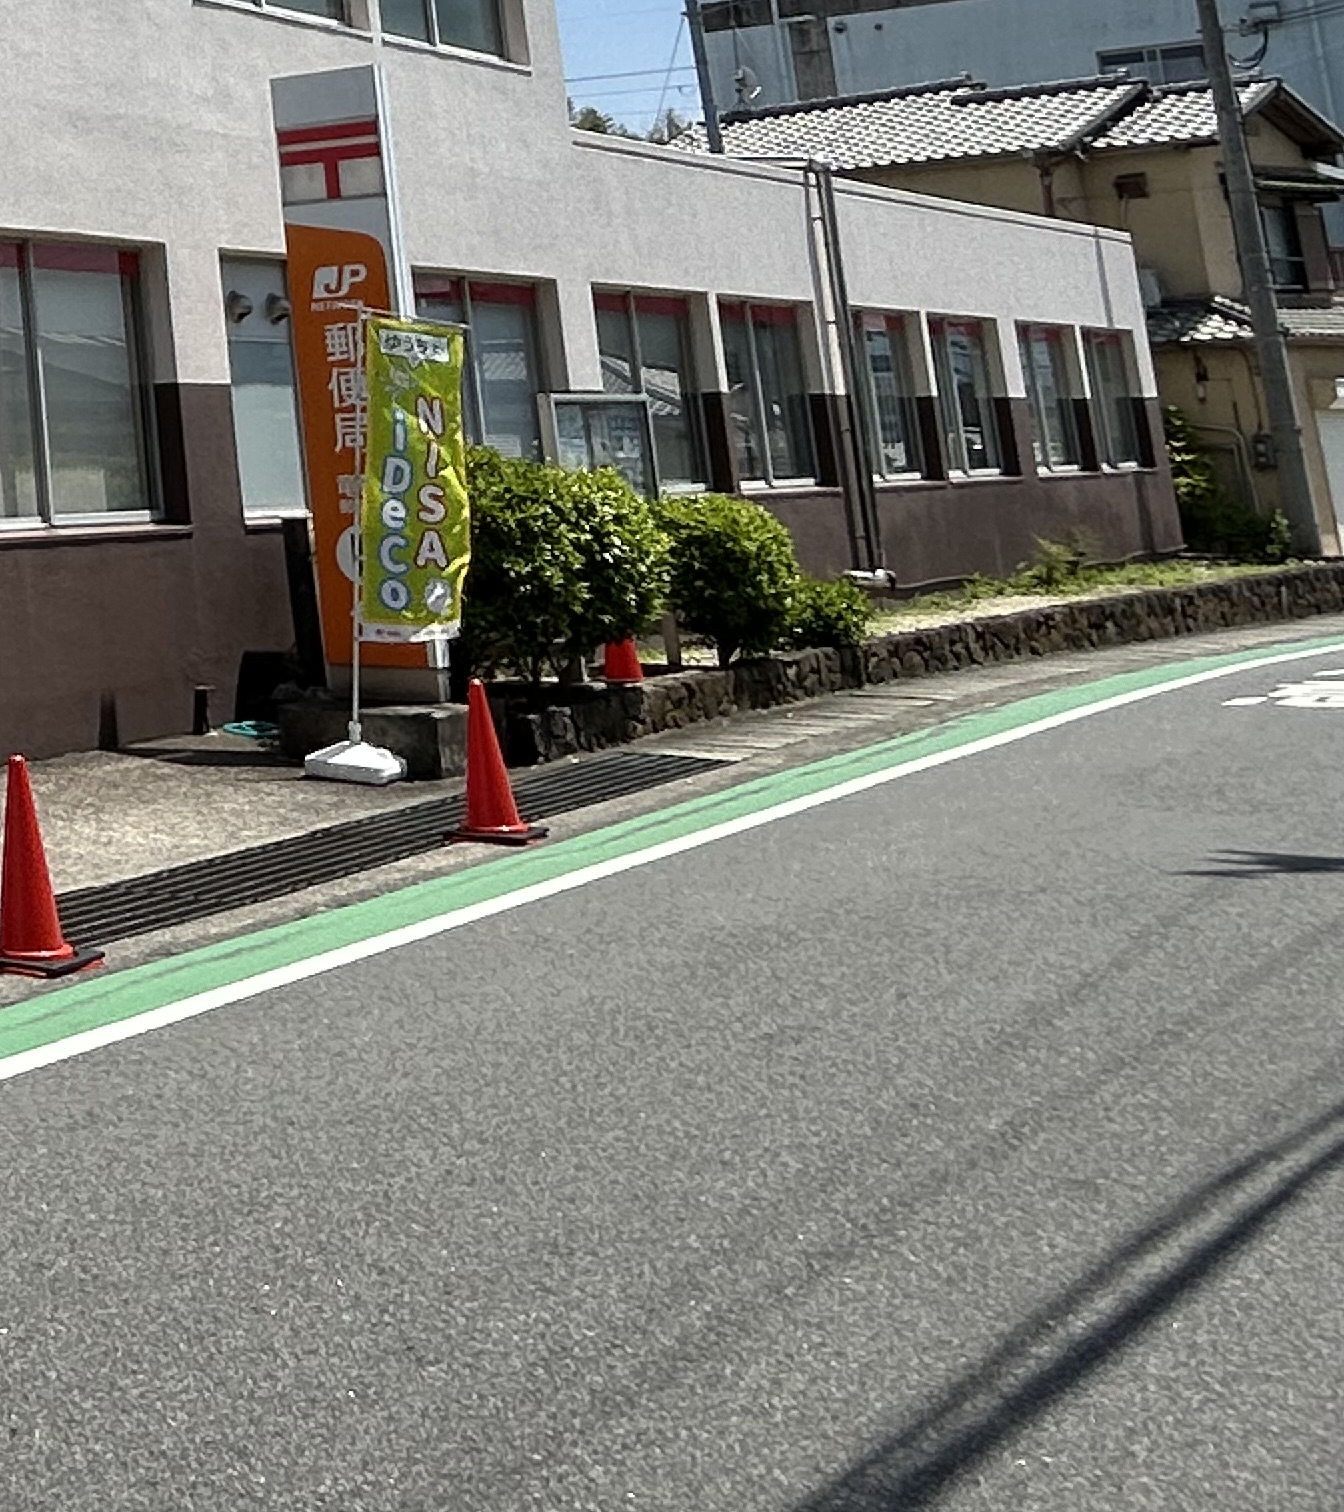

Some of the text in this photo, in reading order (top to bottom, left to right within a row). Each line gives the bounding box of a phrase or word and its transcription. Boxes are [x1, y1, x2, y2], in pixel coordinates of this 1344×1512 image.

[312, 262, 368, 300] JP
[323, 321, 368, 455] 郵便局
[377, 406, 413, 612] iDeCo
[414, 395, 449, 570] NISA
